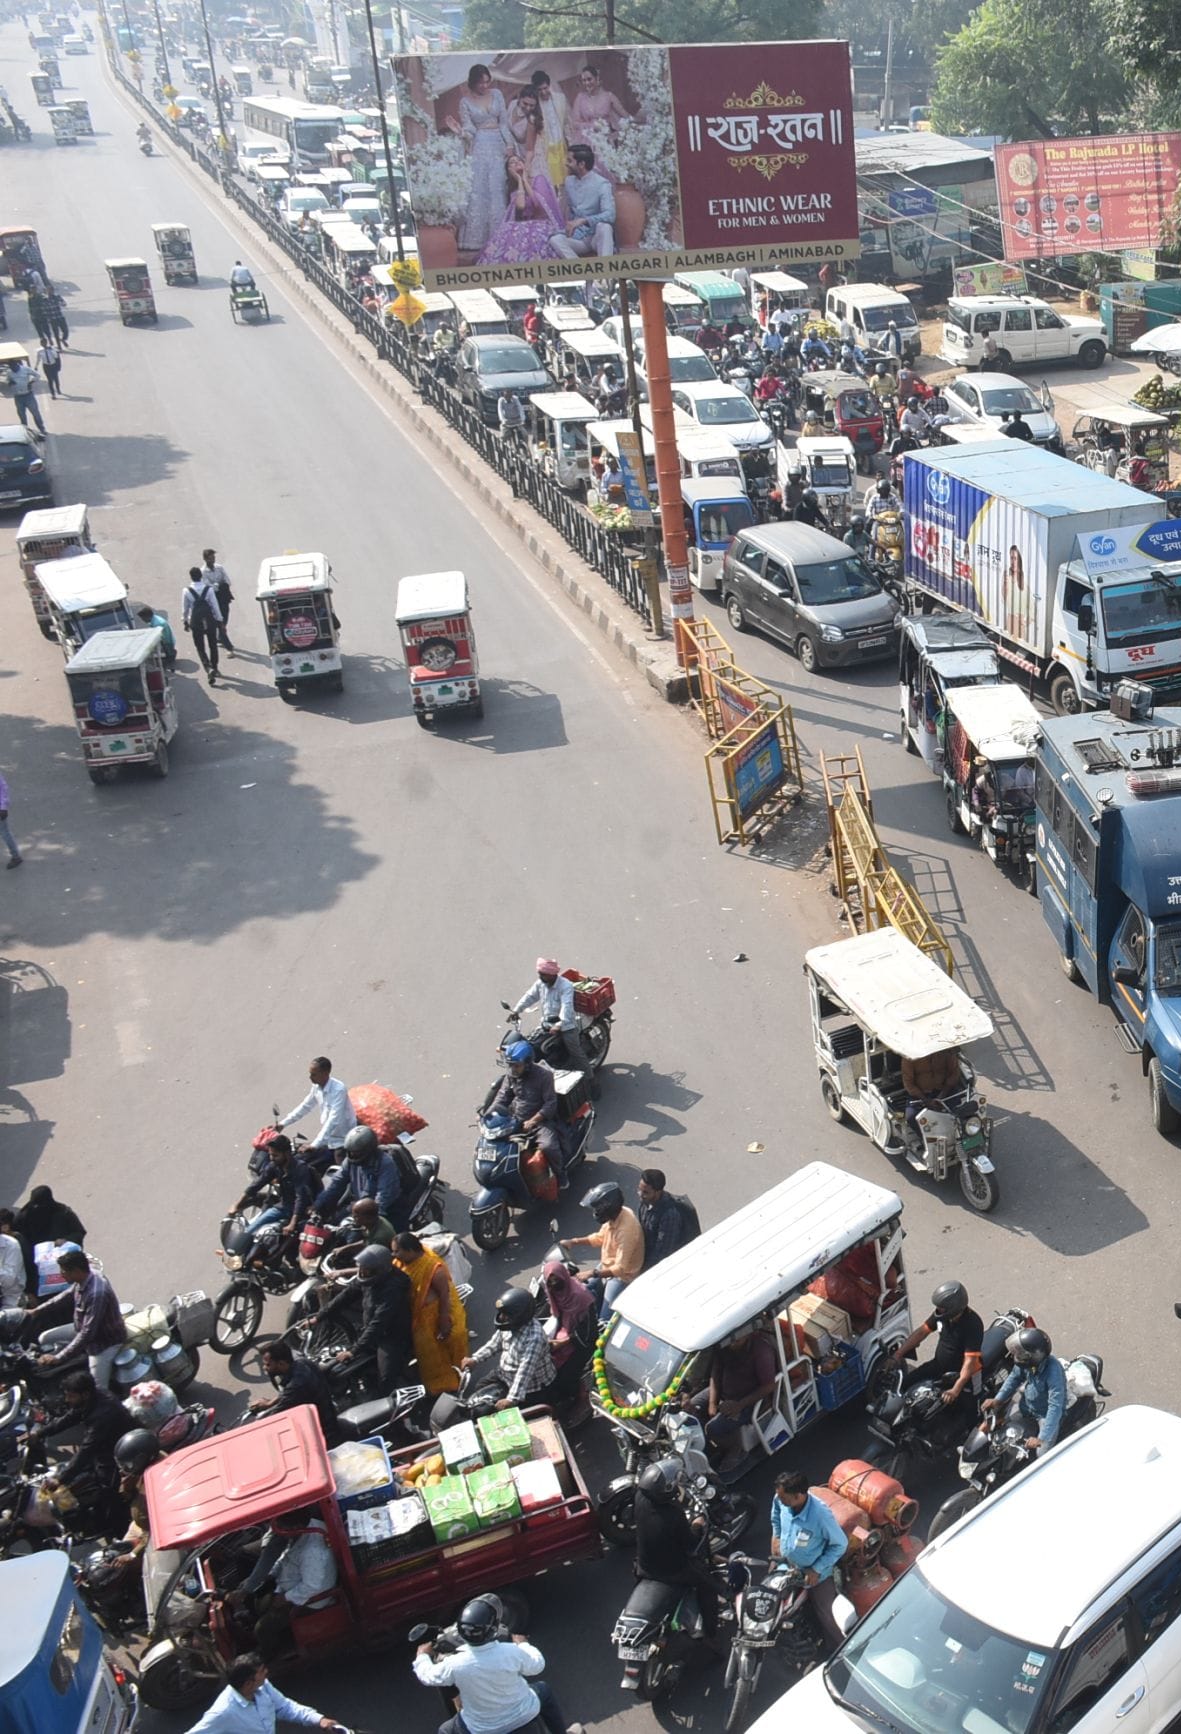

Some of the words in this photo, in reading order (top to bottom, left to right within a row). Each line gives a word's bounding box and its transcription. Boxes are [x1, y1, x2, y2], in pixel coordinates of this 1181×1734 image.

[1044, 148, 1066, 160] The
[1121, 143, 1136, 155] LP
[708, 196, 776, 216] ETHNIC
[779, 193, 833, 211] WEAR
[717, 218, 740, 229] FOR
[742, 216, 767, 226] MEN
[769, 215, 780, 225] &
[782, 212, 825, 224] WOMEN
[436, 267, 534, 285] BHOOTNATH
[547, 261, 605, 277] SINGAR
[608, 257, 662, 273] NAGAR
[674, 250, 756, 267] ALAMBAGH
[768, 245, 844, 260] AMINABAD
[1090, 537, 1115, 553] Gyan
[1148, 533, 1163, 545] दूध
[1125, 645, 1156, 662] दूध
